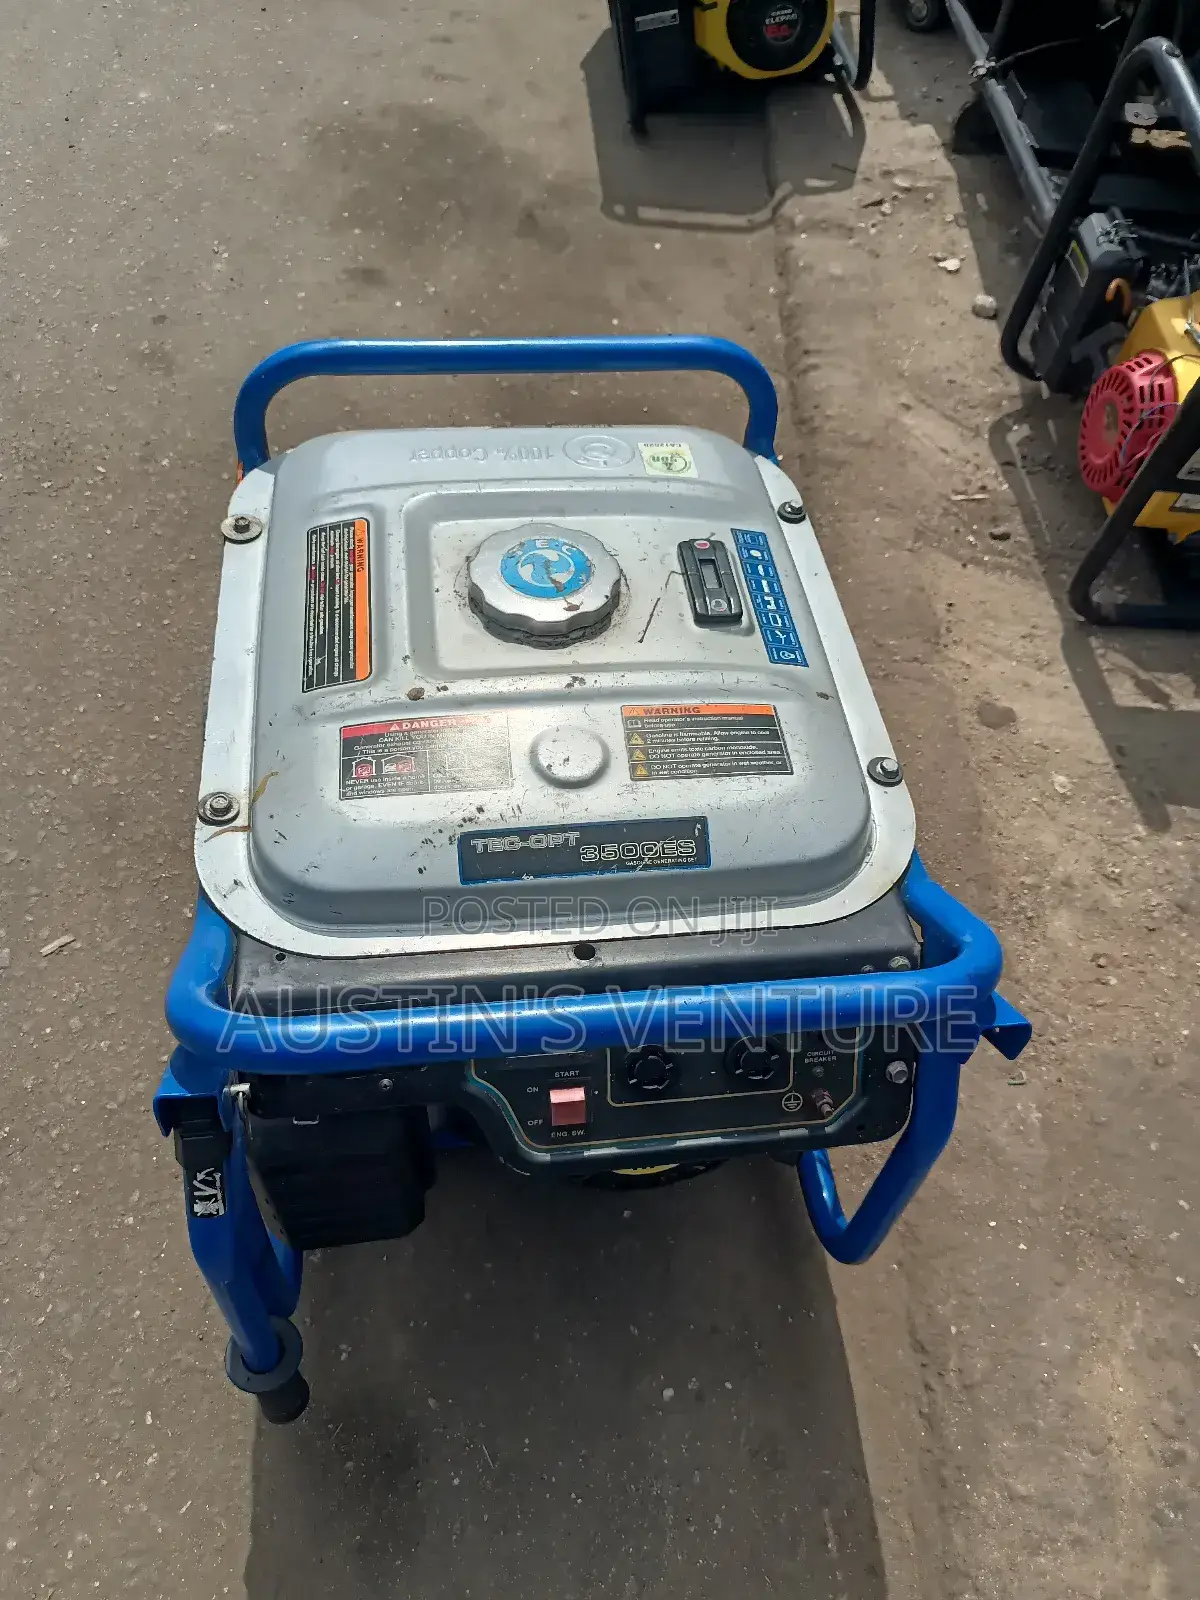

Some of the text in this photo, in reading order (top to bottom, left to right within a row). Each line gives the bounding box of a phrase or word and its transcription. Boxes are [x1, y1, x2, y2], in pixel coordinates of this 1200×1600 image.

[408, 443, 489, 464] Copper
[494, 445, 554, 463] 100%
[356, 537, 365, 573] WARNING
[643, 706, 701, 716] WARNING
[402, 719, 457, 730] DANGER
[353, 743, 386, 751] Generator
[345, 778, 369, 786] NEVER
[470, 831, 580, 854] TEC-OPT
[579, 838, 697, 862] 3500ES
[804, 1055, 837, 1064] BREAKER
[554, 1070, 580, 1078] START
[527, 1118, 544, 1126] OFF
[551, 1129, 586, 1138] ENG. SW.
